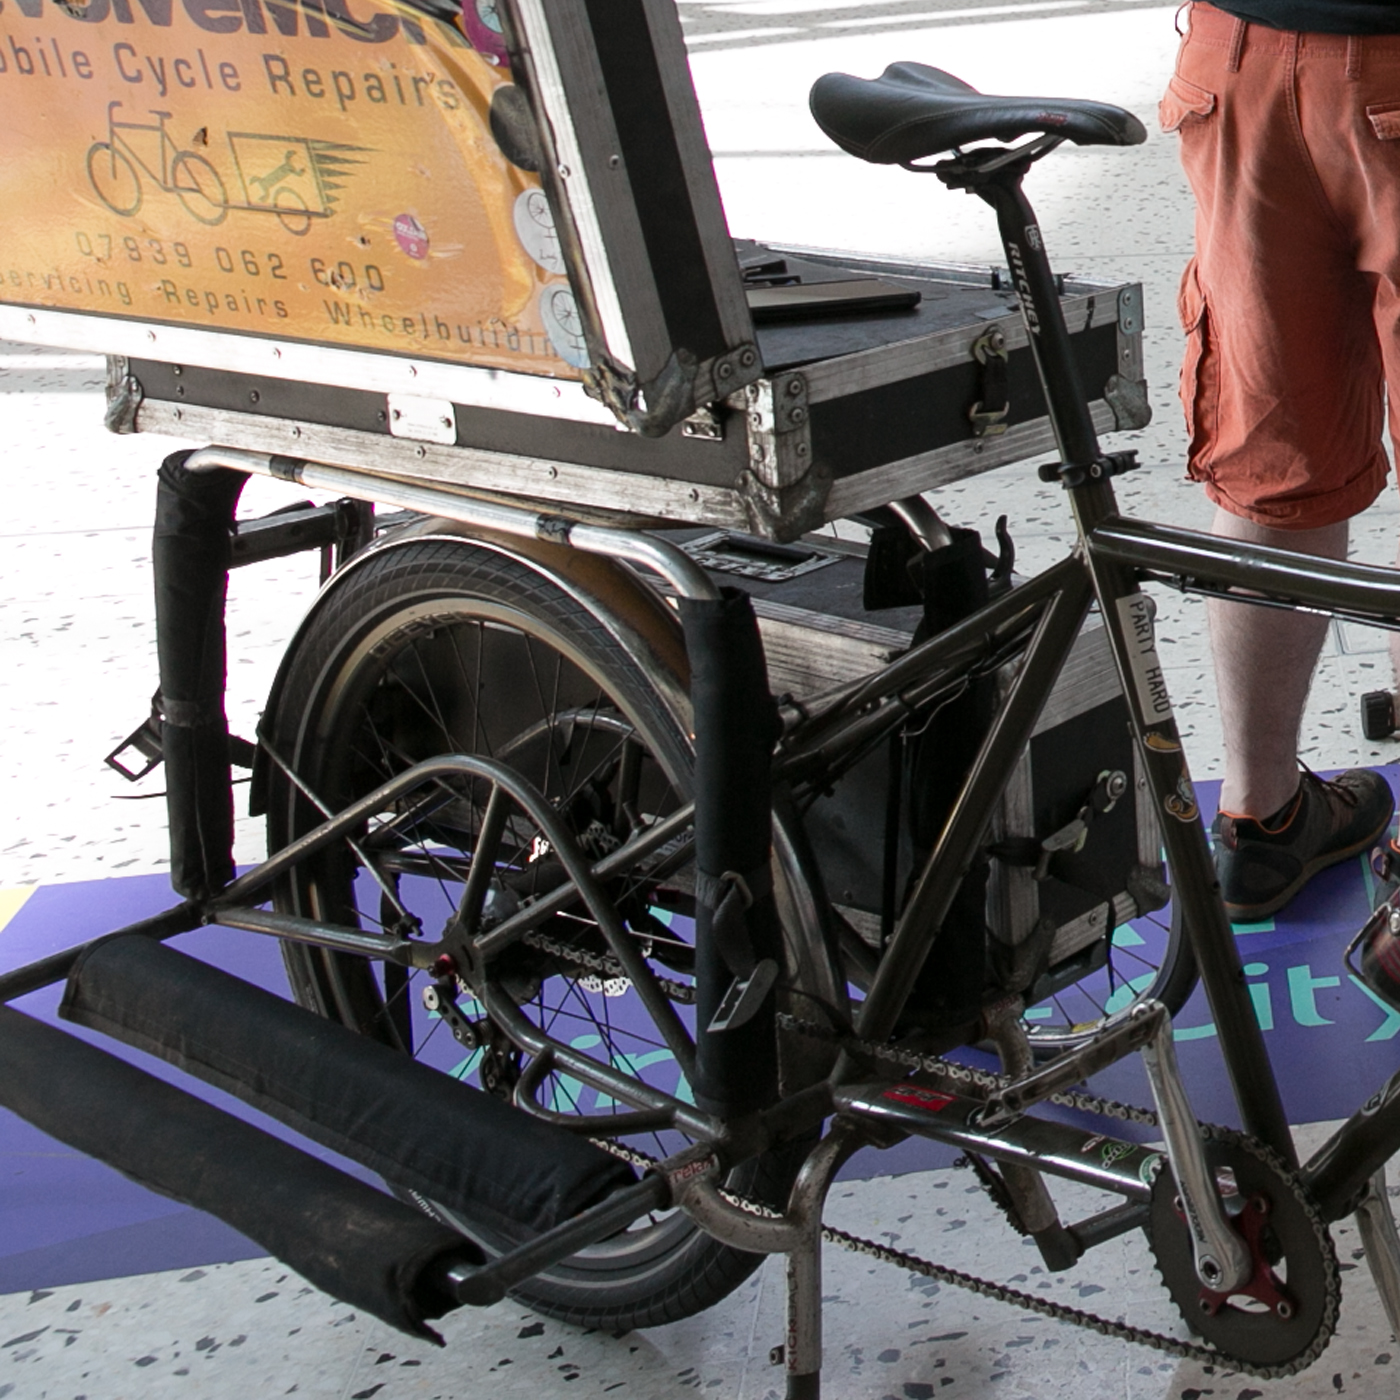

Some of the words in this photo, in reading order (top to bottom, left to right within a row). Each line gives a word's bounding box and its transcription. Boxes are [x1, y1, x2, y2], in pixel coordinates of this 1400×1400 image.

[113, 42, 241, 98] Cycle
[263, 52, 460, 112] Repairs
[75, 230, 194, 269] 07939
[217, 246, 288, 281] 062
[311, 257, 386, 294] 600
[161, 278, 289, 320] Repairs
[1130, 600, 1156, 655] PARTY
[1145, 666, 1171, 714] HARD
